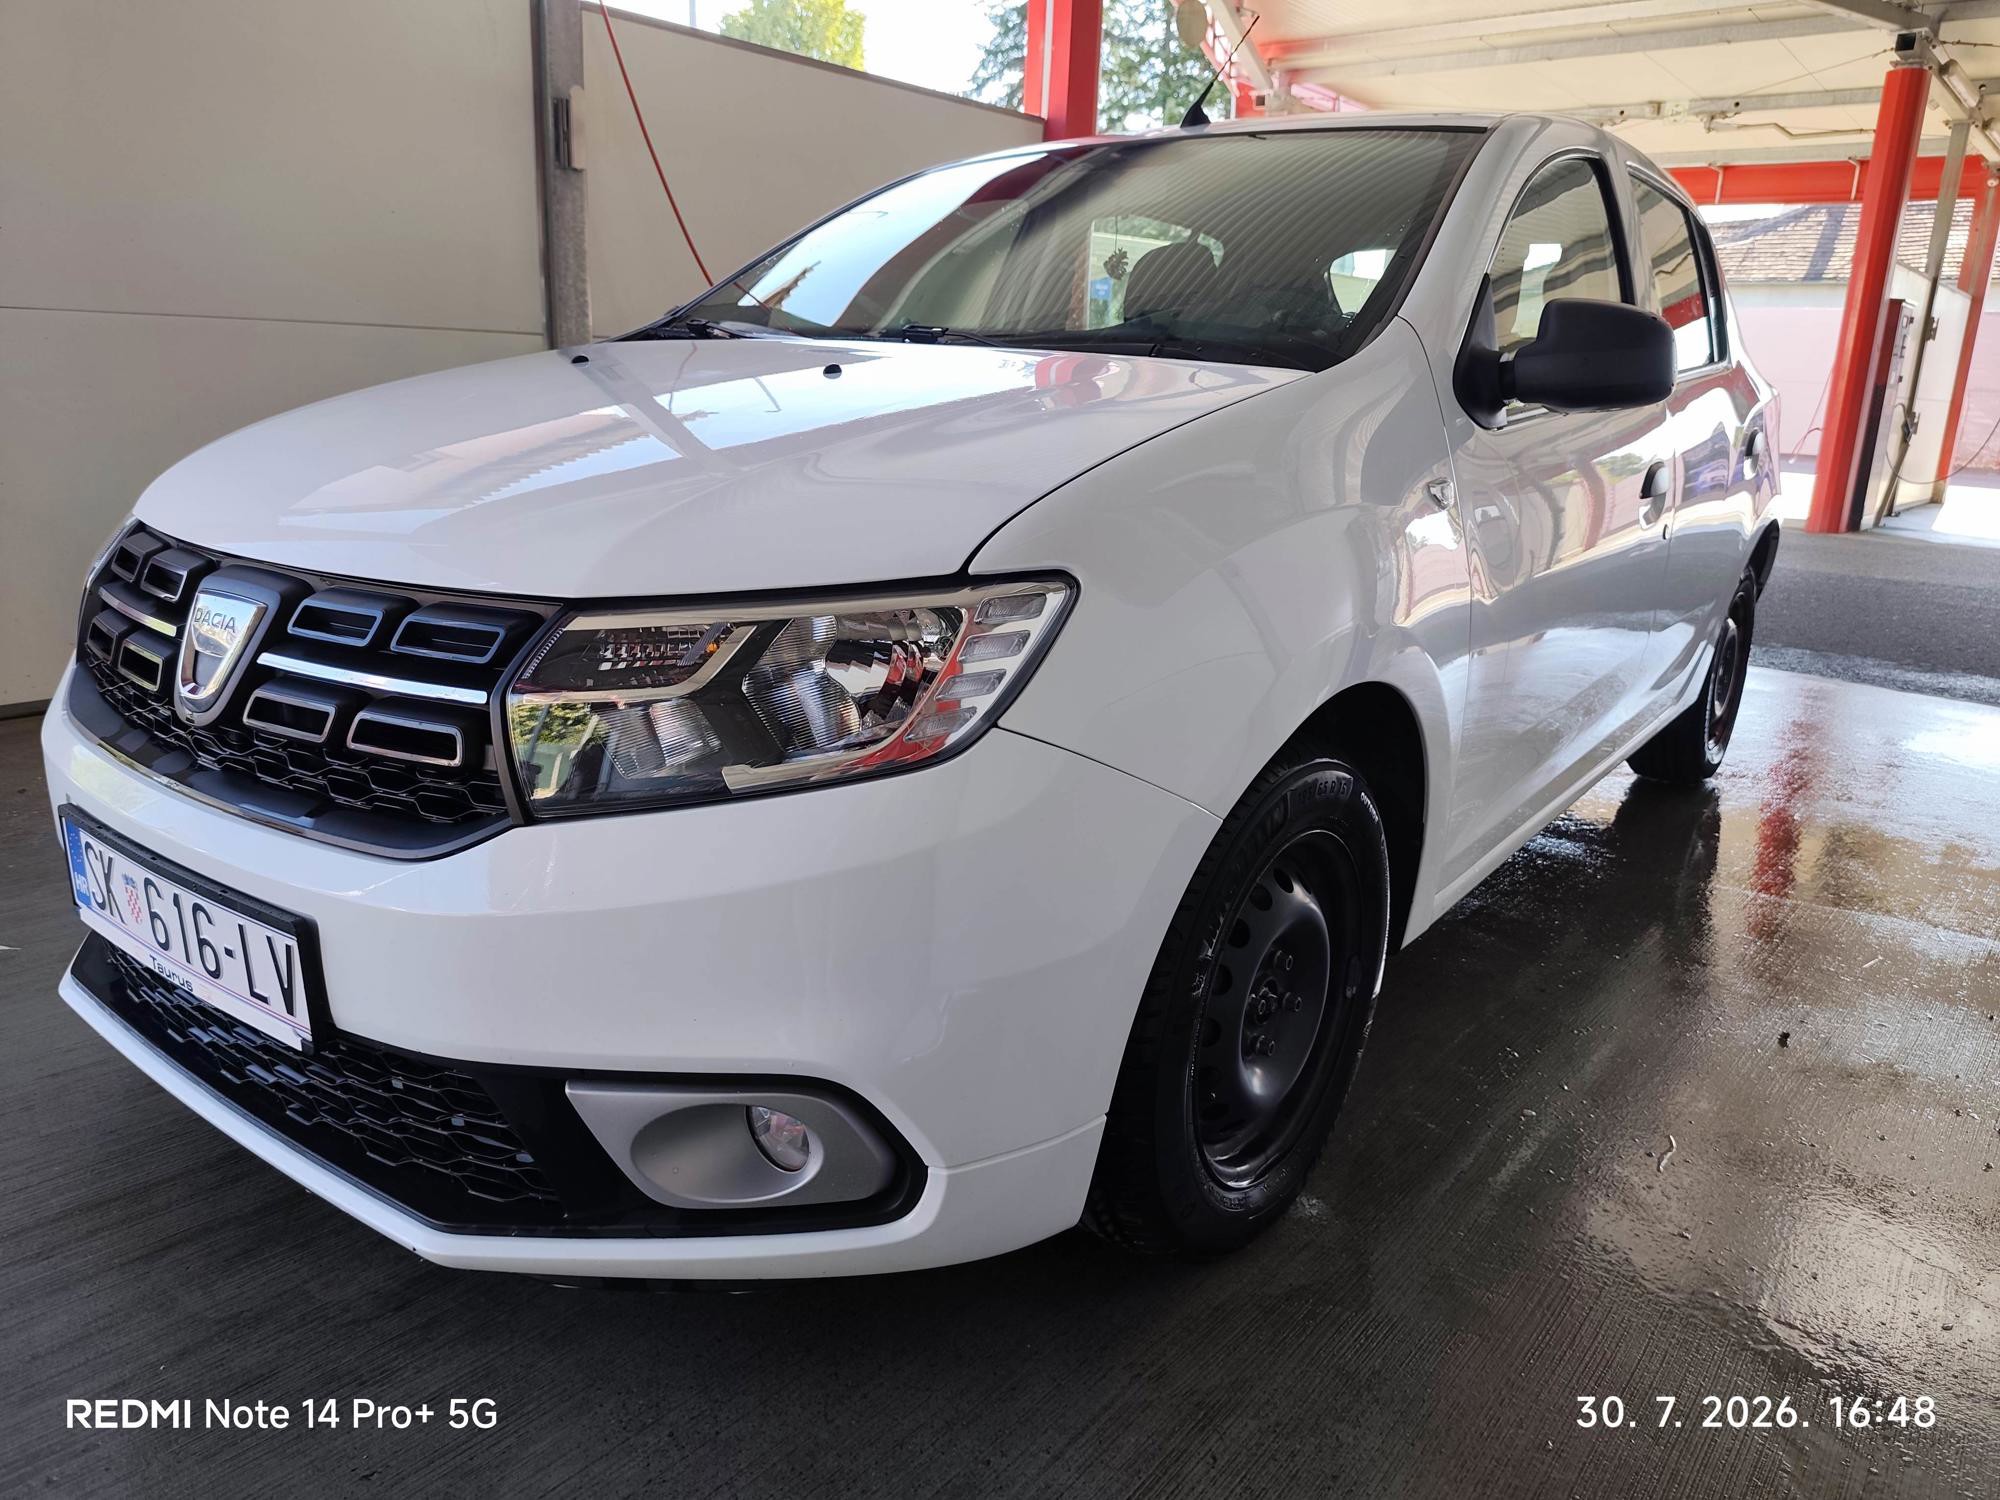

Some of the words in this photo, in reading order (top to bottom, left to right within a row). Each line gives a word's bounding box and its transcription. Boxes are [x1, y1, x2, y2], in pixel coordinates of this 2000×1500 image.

[194, 607, 237, 633] DACIA
[74, 871, 90, 897] HR
[84, 841, 127, 925] SK
[143, 877, 297, 1018] 616-LV
[149, 954, 194, 992] Taurus
